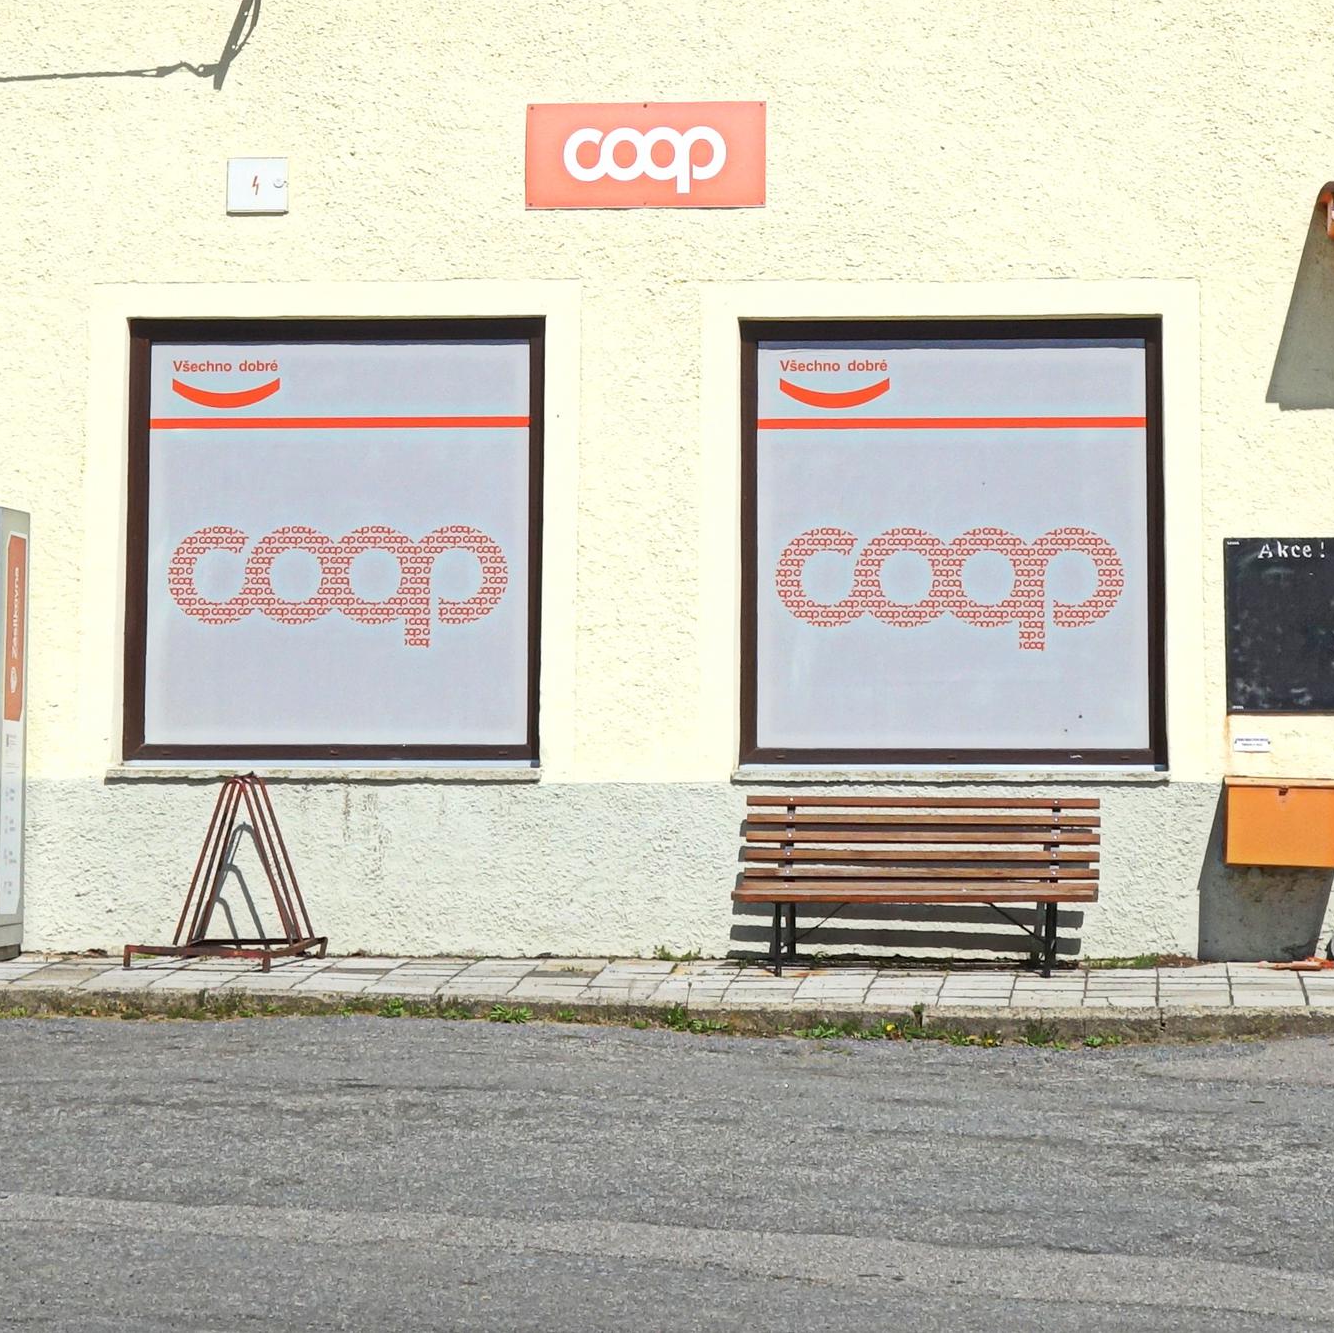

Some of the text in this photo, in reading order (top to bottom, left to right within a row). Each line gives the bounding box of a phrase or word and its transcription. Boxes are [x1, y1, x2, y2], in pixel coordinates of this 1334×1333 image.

[563, 126, 727, 194] coop
[172, 359, 278, 372] Všechno dobré
[779, 359, 888, 372] Všechno dobré
[1257, 540, 1313, 559] Akce
[169, 526, 508, 648] coop
[776, 527, 1123, 651] coop
